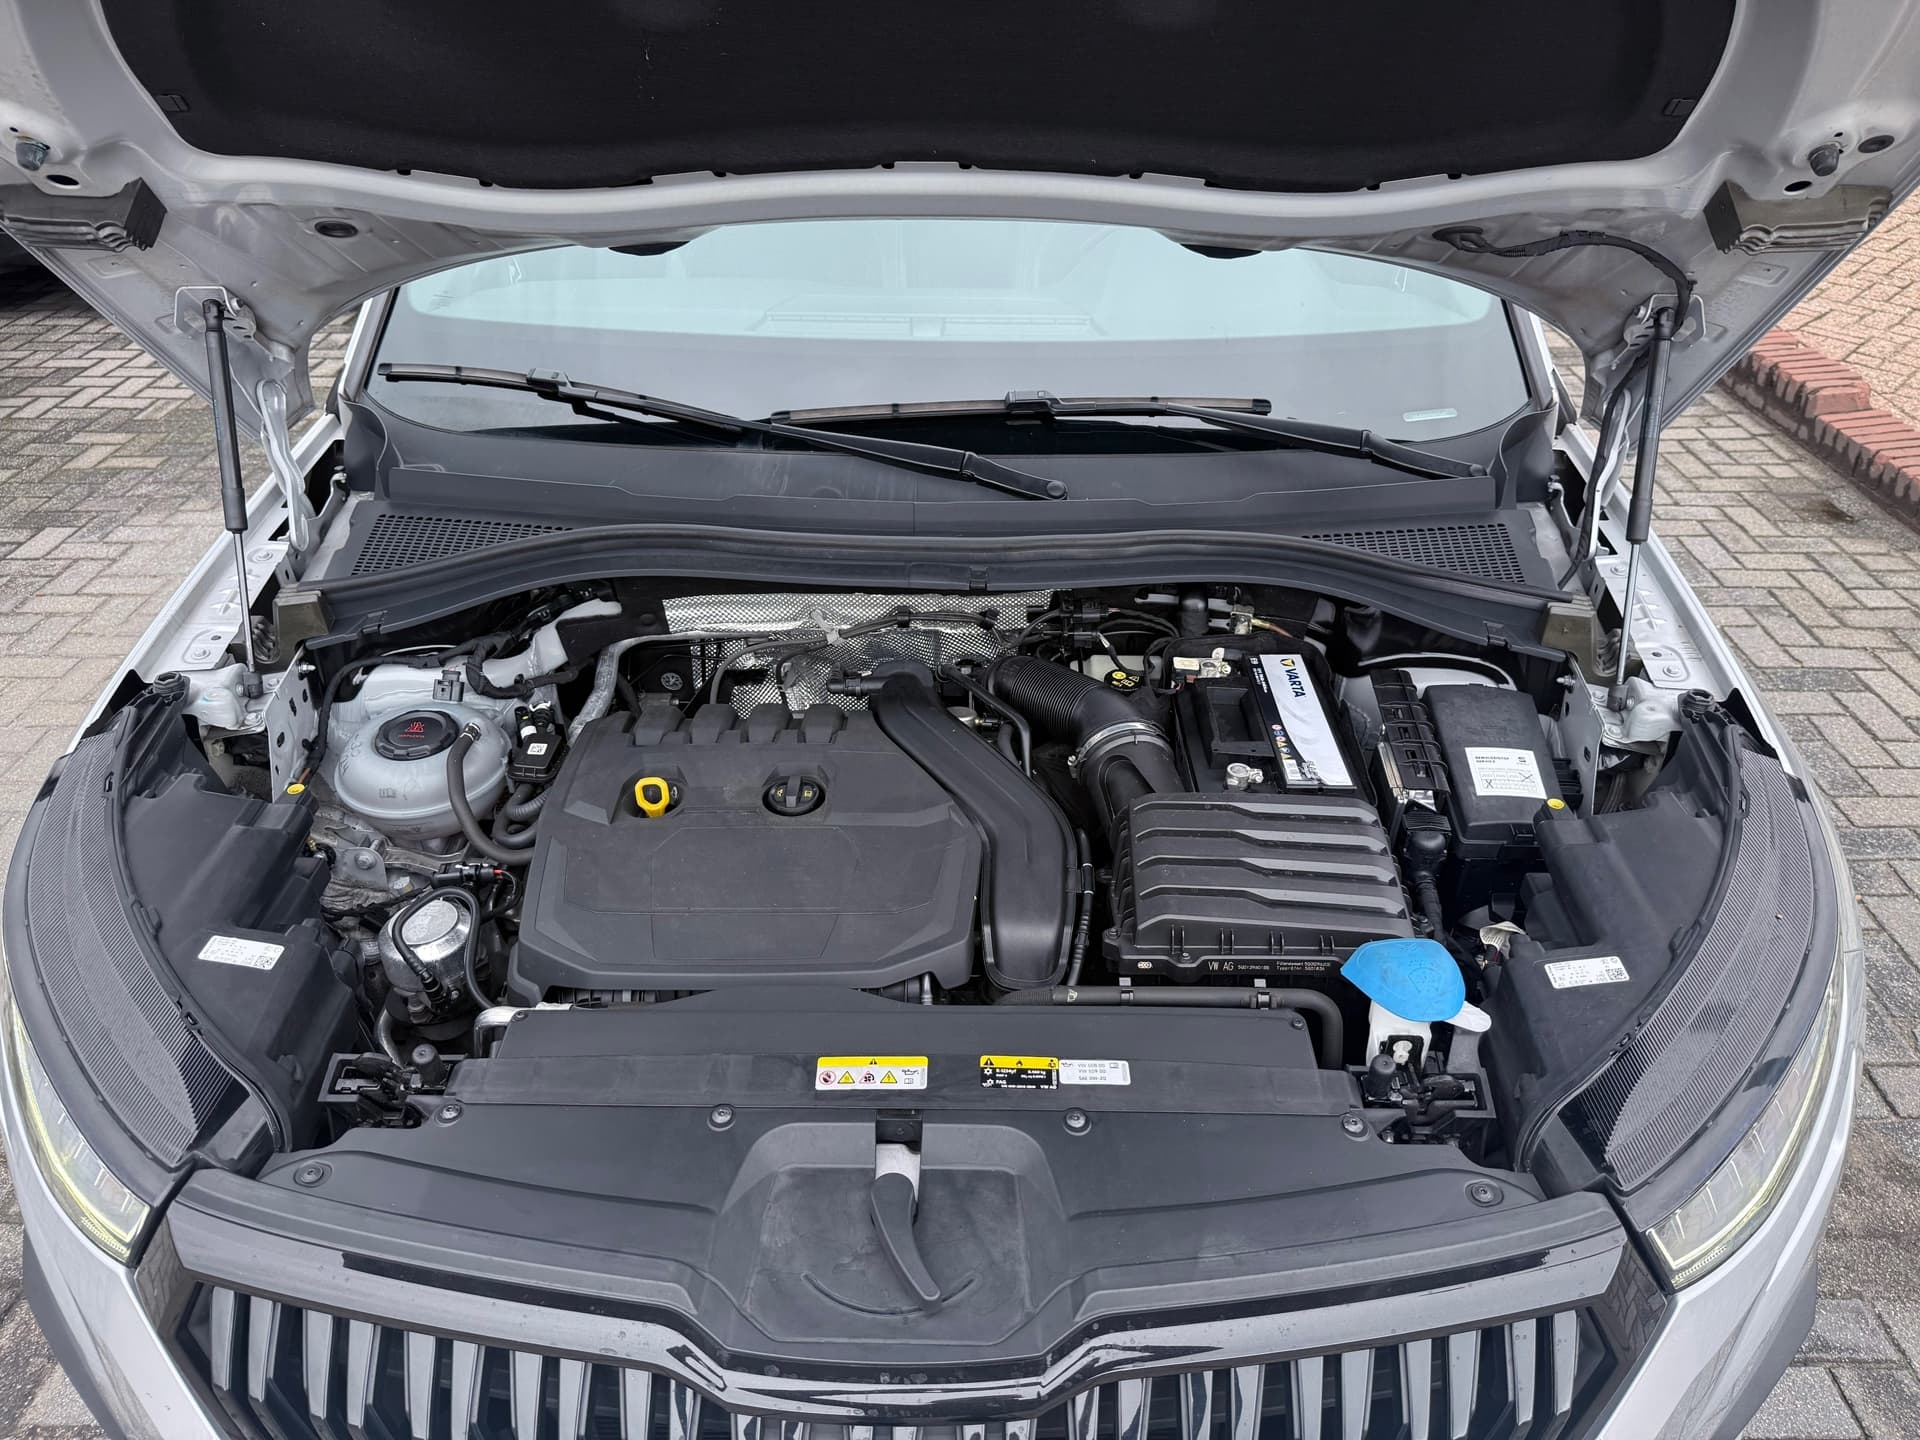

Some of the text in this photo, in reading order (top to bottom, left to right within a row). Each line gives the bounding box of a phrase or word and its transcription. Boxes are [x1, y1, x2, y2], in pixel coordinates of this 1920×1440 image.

[1285, 668, 1306, 698] VARTA
[1208, 961, 1219, 971] VW
[1223, 961, 1235, 971] AG
